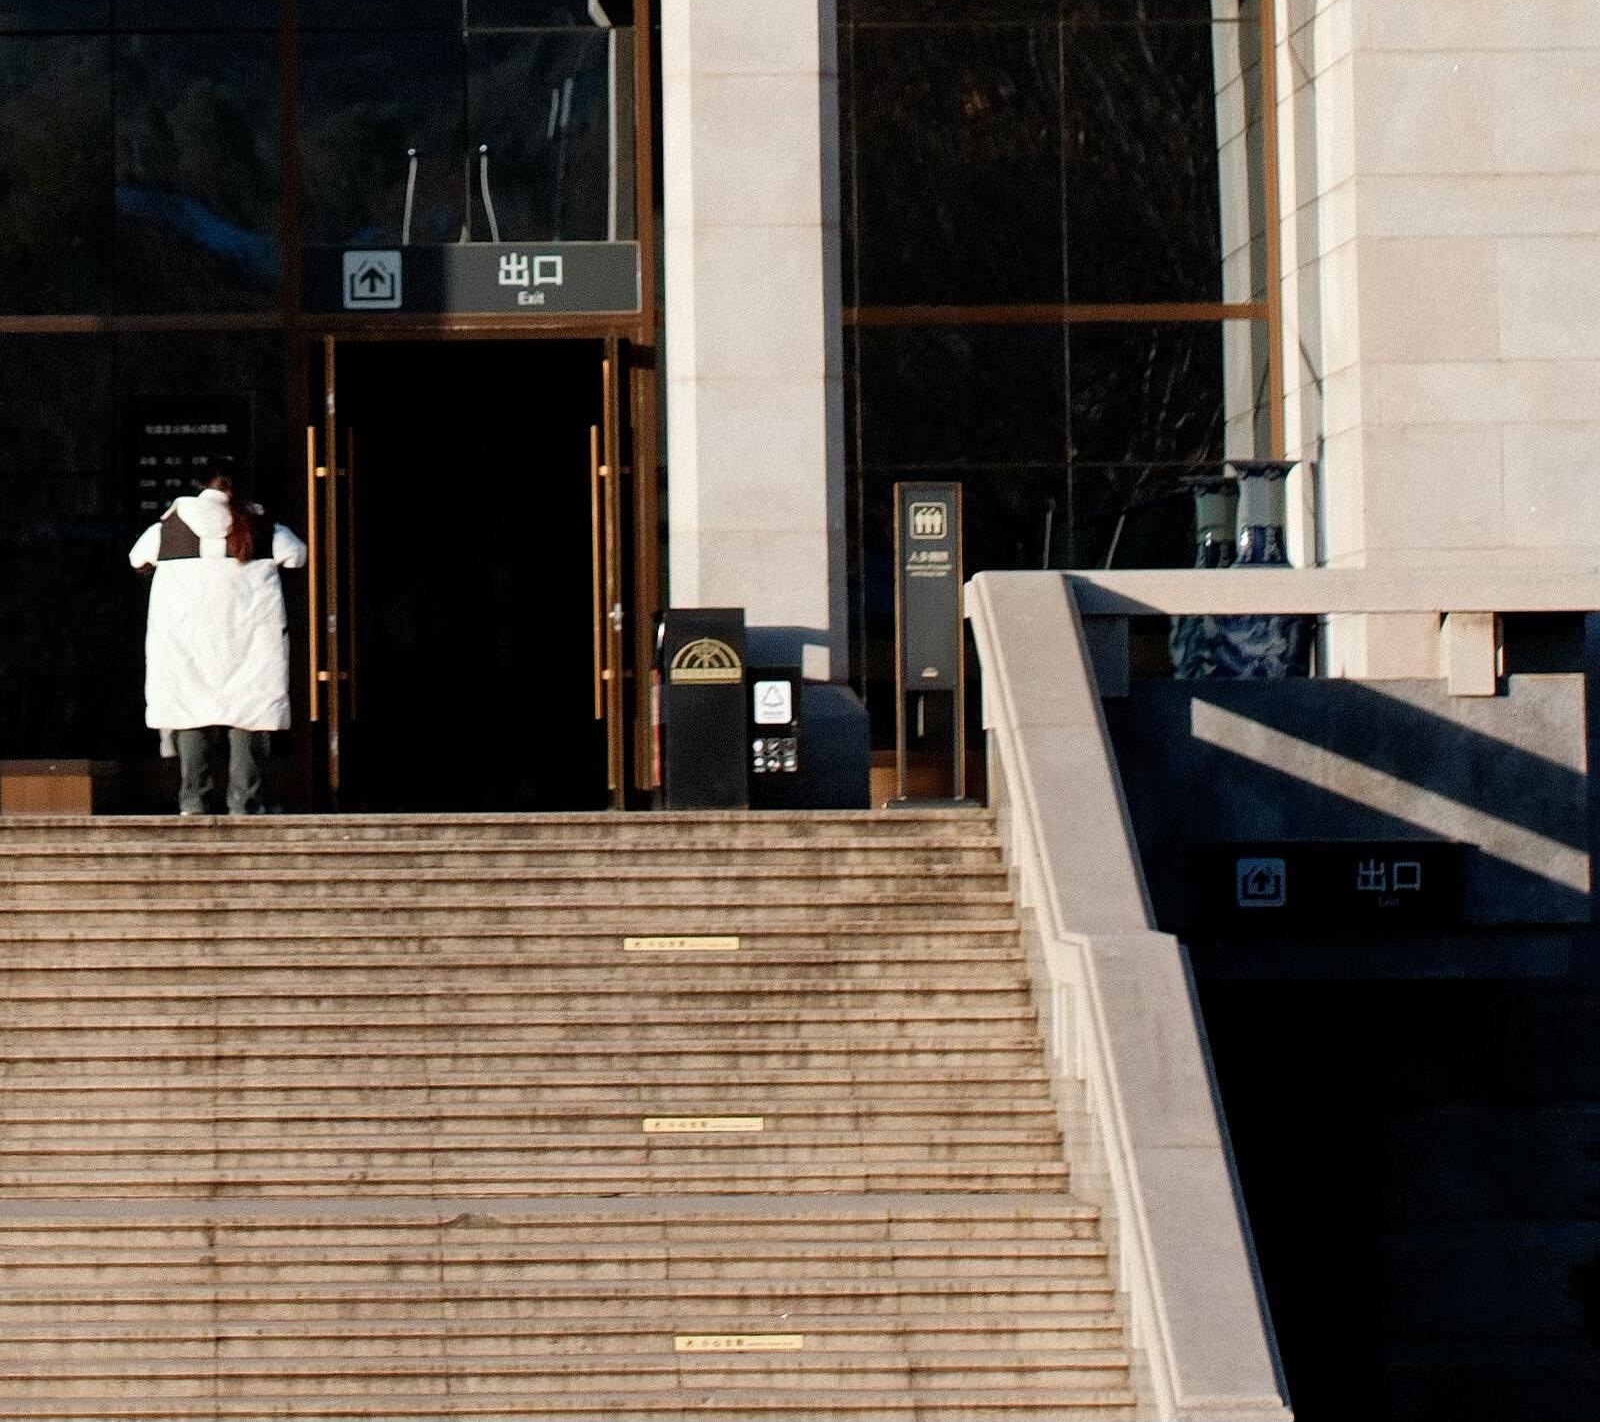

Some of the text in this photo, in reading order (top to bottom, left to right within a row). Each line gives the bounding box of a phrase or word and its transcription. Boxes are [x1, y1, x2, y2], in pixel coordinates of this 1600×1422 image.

[499, 252, 563, 287] 出口
[518, 291, 545, 305] Exit
[1356, 858, 1422, 892] 出口
